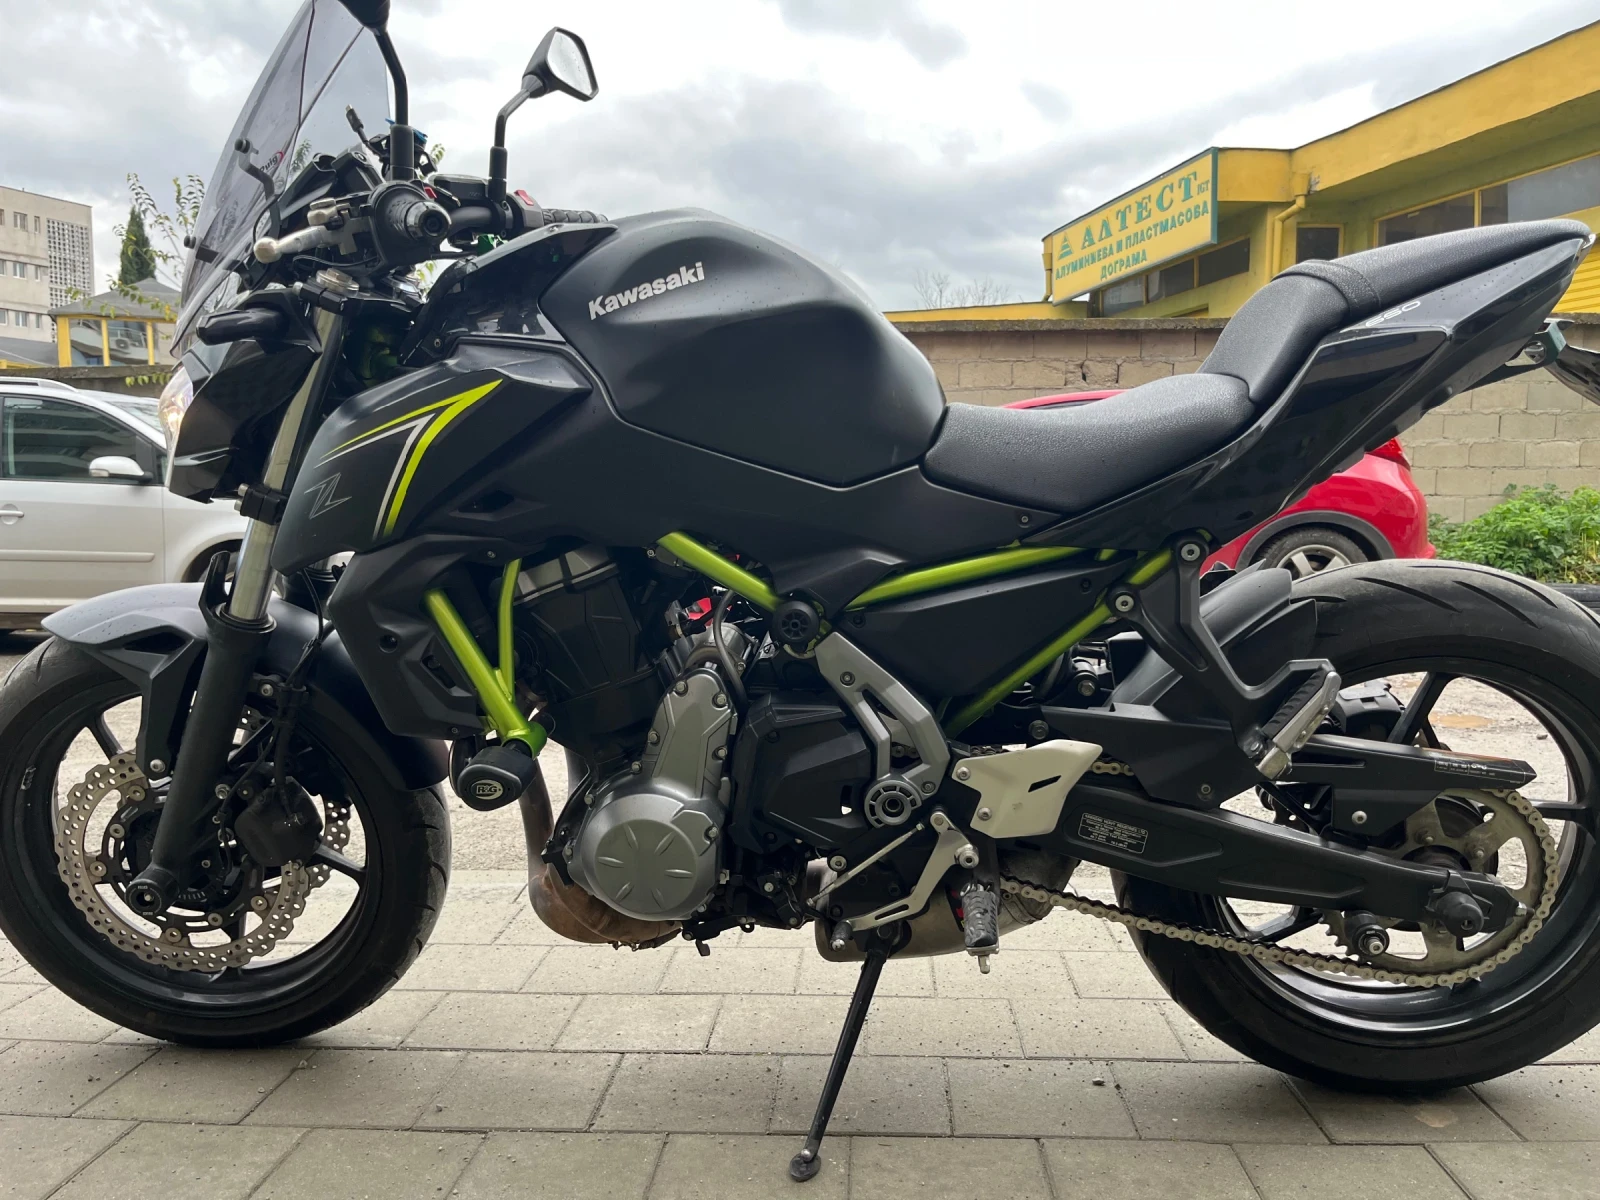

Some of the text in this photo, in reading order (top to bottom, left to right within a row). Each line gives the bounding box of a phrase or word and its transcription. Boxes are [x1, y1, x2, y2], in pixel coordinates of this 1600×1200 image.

[1055, 200, 1209, 280] АЛУМИНИЕВА И ПЛАСТМАСОВА
[1081, 171, 1197, 250] АЛТЕСТ
[588, 261, 705, 320] Kawasaki
[1100, 249, 1147, 281] ДОГРАМА
